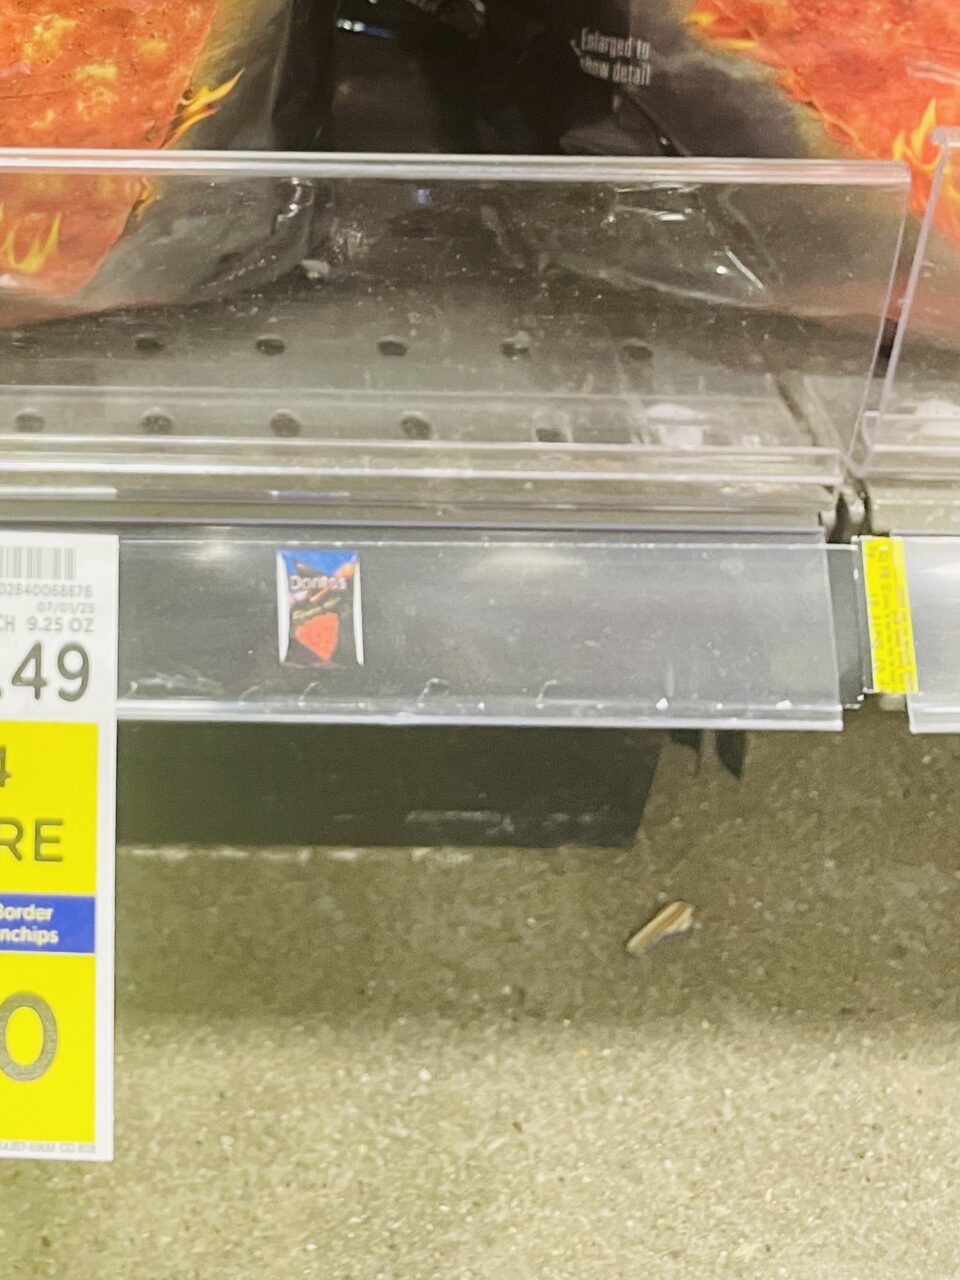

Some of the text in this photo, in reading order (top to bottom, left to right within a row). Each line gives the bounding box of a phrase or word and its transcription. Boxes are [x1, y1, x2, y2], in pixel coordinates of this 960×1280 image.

[612, 61, 651, 86] detail
[27, 616, 64, 632] 9.25
[68, 618, 95, 633] OZ
